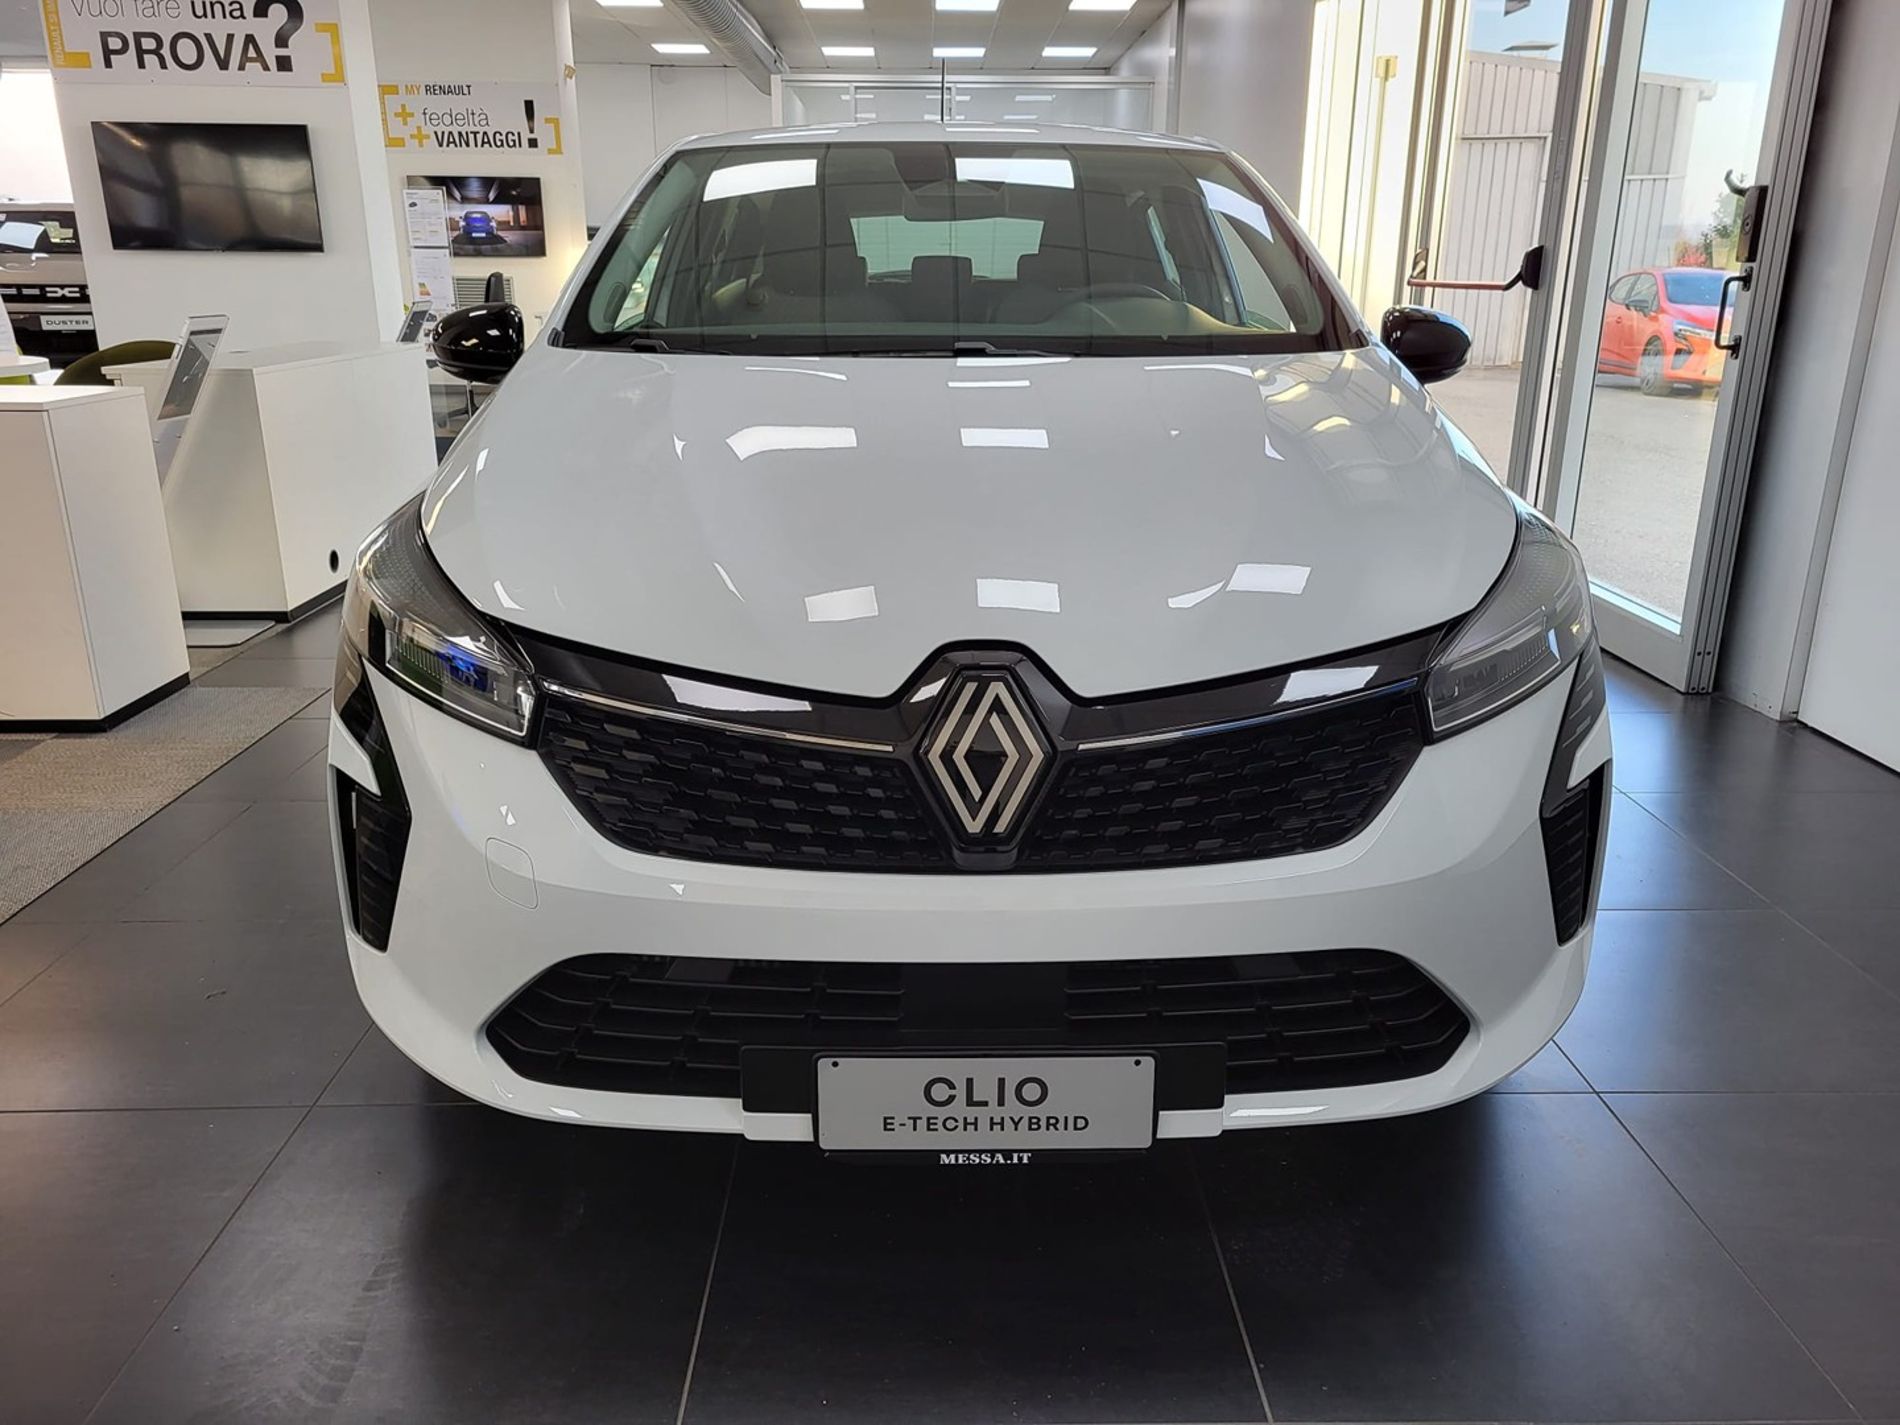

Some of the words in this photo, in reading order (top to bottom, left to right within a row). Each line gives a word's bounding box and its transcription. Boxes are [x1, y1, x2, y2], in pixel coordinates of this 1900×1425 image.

[190, 0, 247, 20] una
[404, 84, 421, 96] MY
[424, 84, 472, 96] RENAULT
[422, 107, 490, 127] fedeltà
[923, 1076, 1049, 1107] CLIO
[882, 1116, 979, 1132] E-TECH
[989, 1115, 1090, 1132] HYBRID
[939, 1152, 1032, 1165] MESSA.IT
